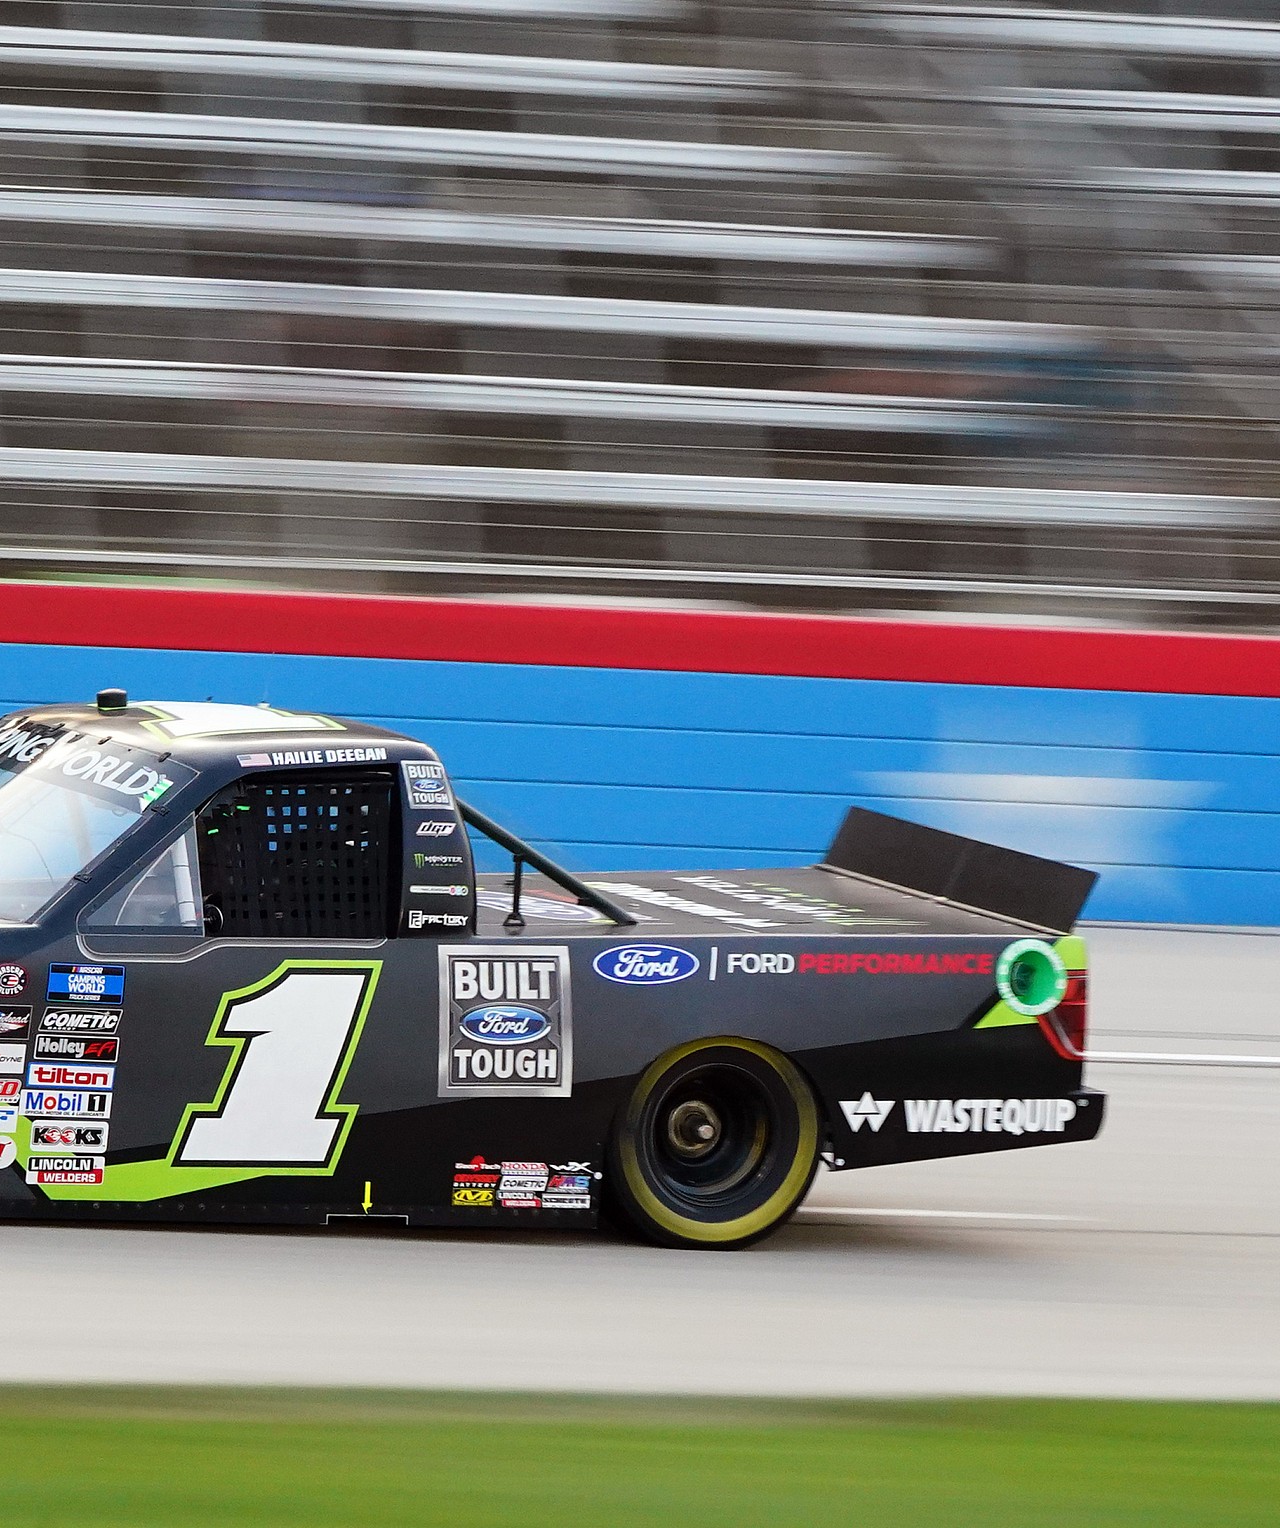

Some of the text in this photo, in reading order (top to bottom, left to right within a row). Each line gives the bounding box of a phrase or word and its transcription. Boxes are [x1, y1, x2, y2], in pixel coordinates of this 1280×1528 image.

[272, 747, 388, 766] HAILIE DEEGAN
[408, 765, 443, 779] BUILT
[412, 793, 450, 804] TOUGH
[422, 913, 469, 927] FACTORY
[612, 949, 994, 977] Ford FORD PERFORMANCE
[67, 974, 106, 985] CAMPING
[67, 982, 106, 994] WORLD
[454, 961, 556, 1000] BUILT
[43, 1012, 118, 1029] COMETIC
[478, 1010, 531, 1034] Ford
[37, 1037, 86, 1058] Holley
[176, 968, 375, 1168] 1
[453, 1048, 558, 1079] TOUGH
[34, 1066, 109, 1086] tilton
[25, 1092, 83, 1112] Mobil
[903, 1099, 1078, 1136] WASTEQUIP
[33, 1126, 103, 1146] KOOKS
[30, 1158, 92, 1172] LINCOLN
[502, 1162, 547, 1170] HONDA
[42, 1172, 97, 1184] WELDERS
[502, 1179, 546, 1188] COMETIC
